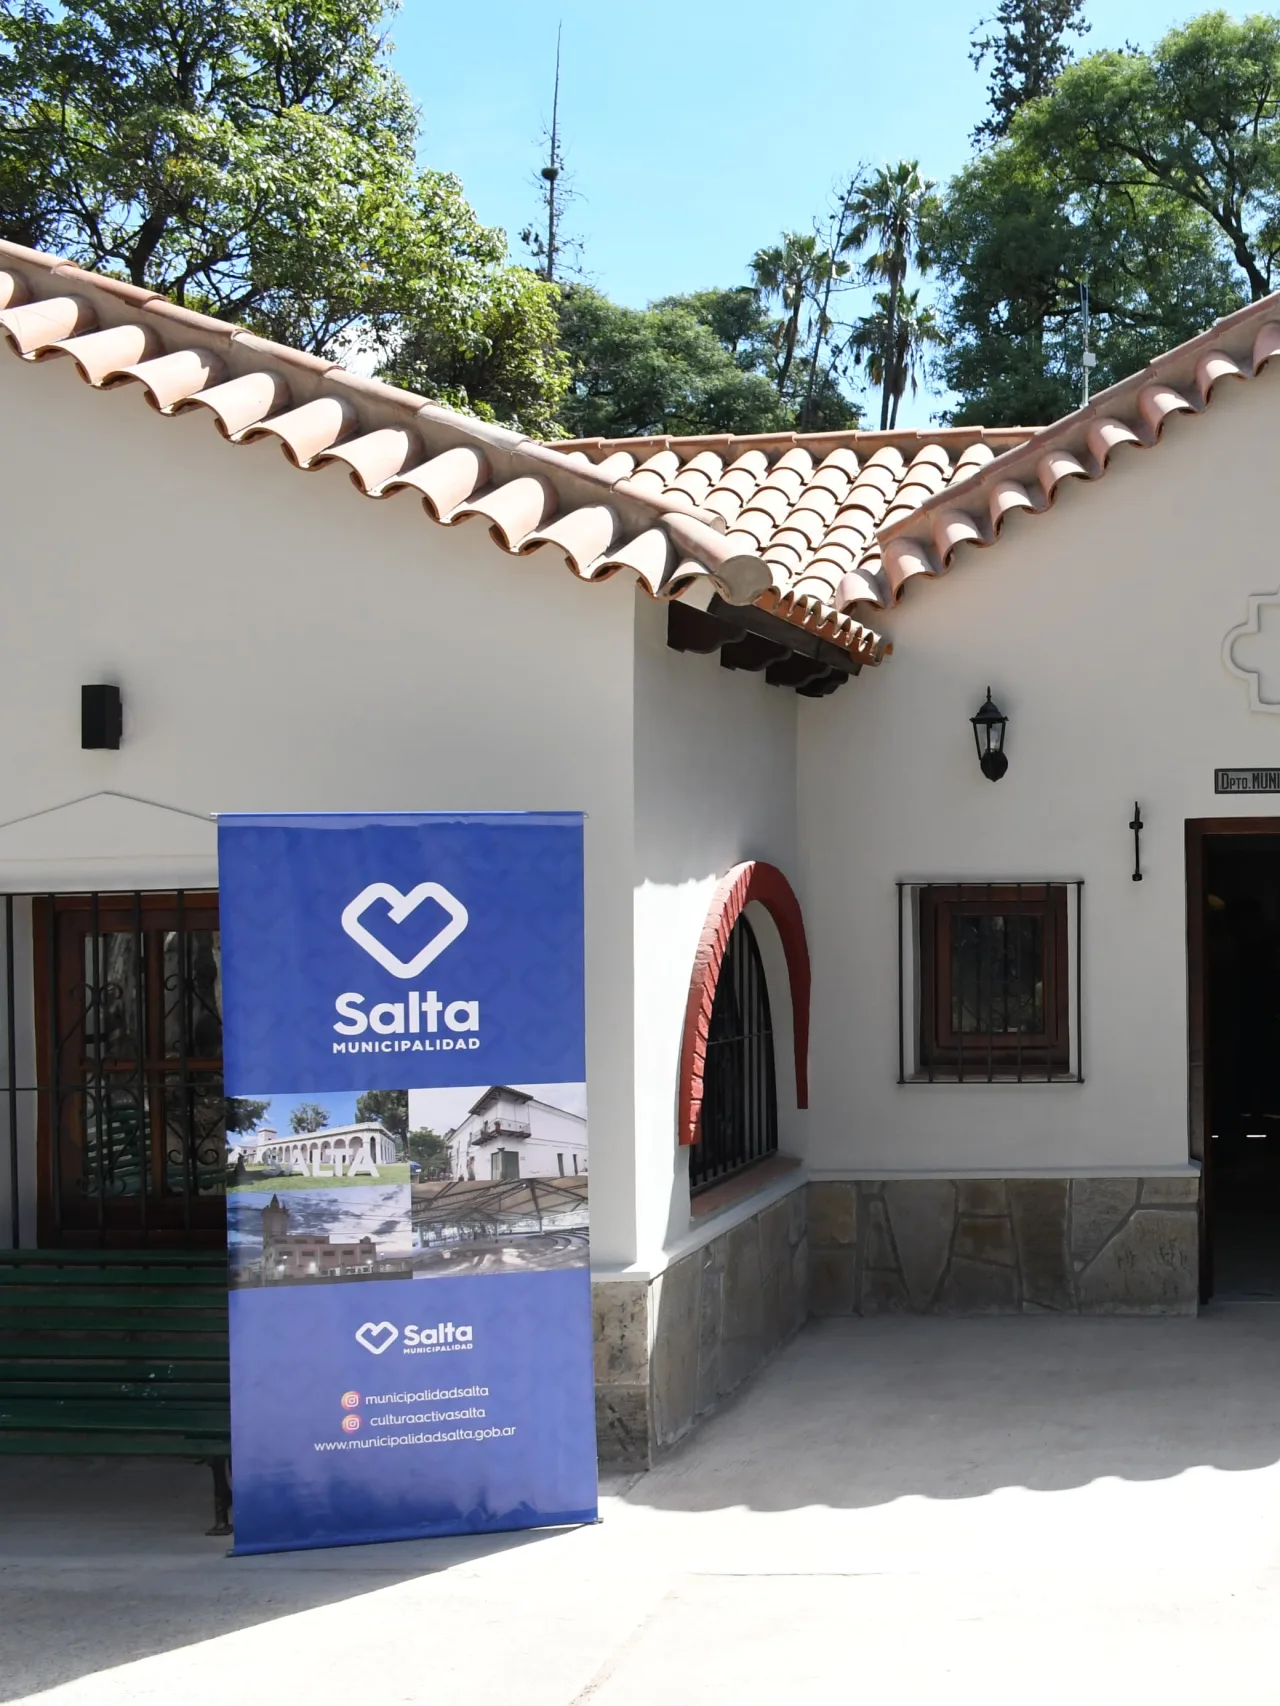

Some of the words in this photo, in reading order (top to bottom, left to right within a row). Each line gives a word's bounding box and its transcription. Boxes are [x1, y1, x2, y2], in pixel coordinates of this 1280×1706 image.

[333, 990, 479, 1035] Salta
[333, 1038, 480, 1054] MUNICIPALIDAD
[261, 1148, 380, 1178] SALTA
[404, 1322, 473, 1345] Salta
[404, 1343, 473, 1354] MUNICIPALIDAD
[365, 1385, 489, 1405] municipalidadsalta
[370, 1407, 486, 1427] culturaactivasalta
[314, 1425, 517, 1451] www.municipalidadsalta.gob.ar
